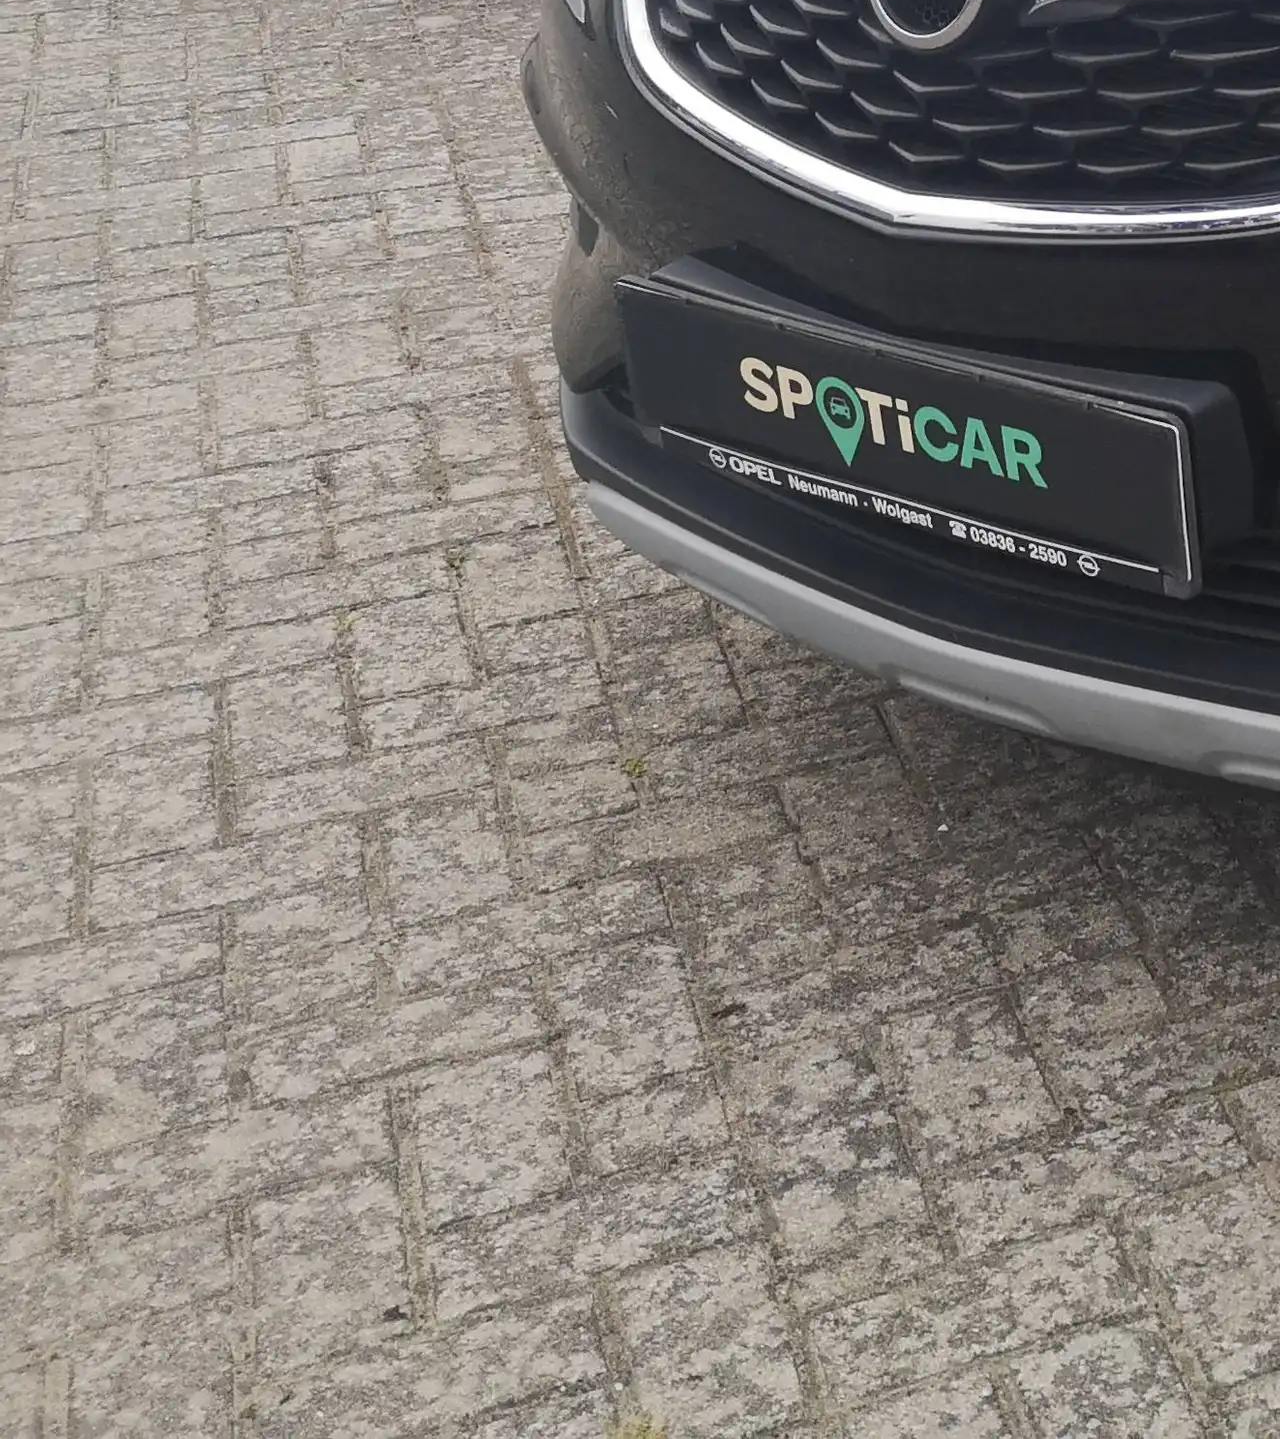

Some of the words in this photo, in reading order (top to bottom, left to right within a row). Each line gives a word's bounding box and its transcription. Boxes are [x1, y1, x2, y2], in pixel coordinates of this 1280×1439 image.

[728, 456, 782, 486] OPEL
[787, 474, 859, 507] Neumann
[872, 497, 933, 529] Wolgast
[969, 526, 1016, 554] 03836
[1028, 543, 1068, 567] 2590
